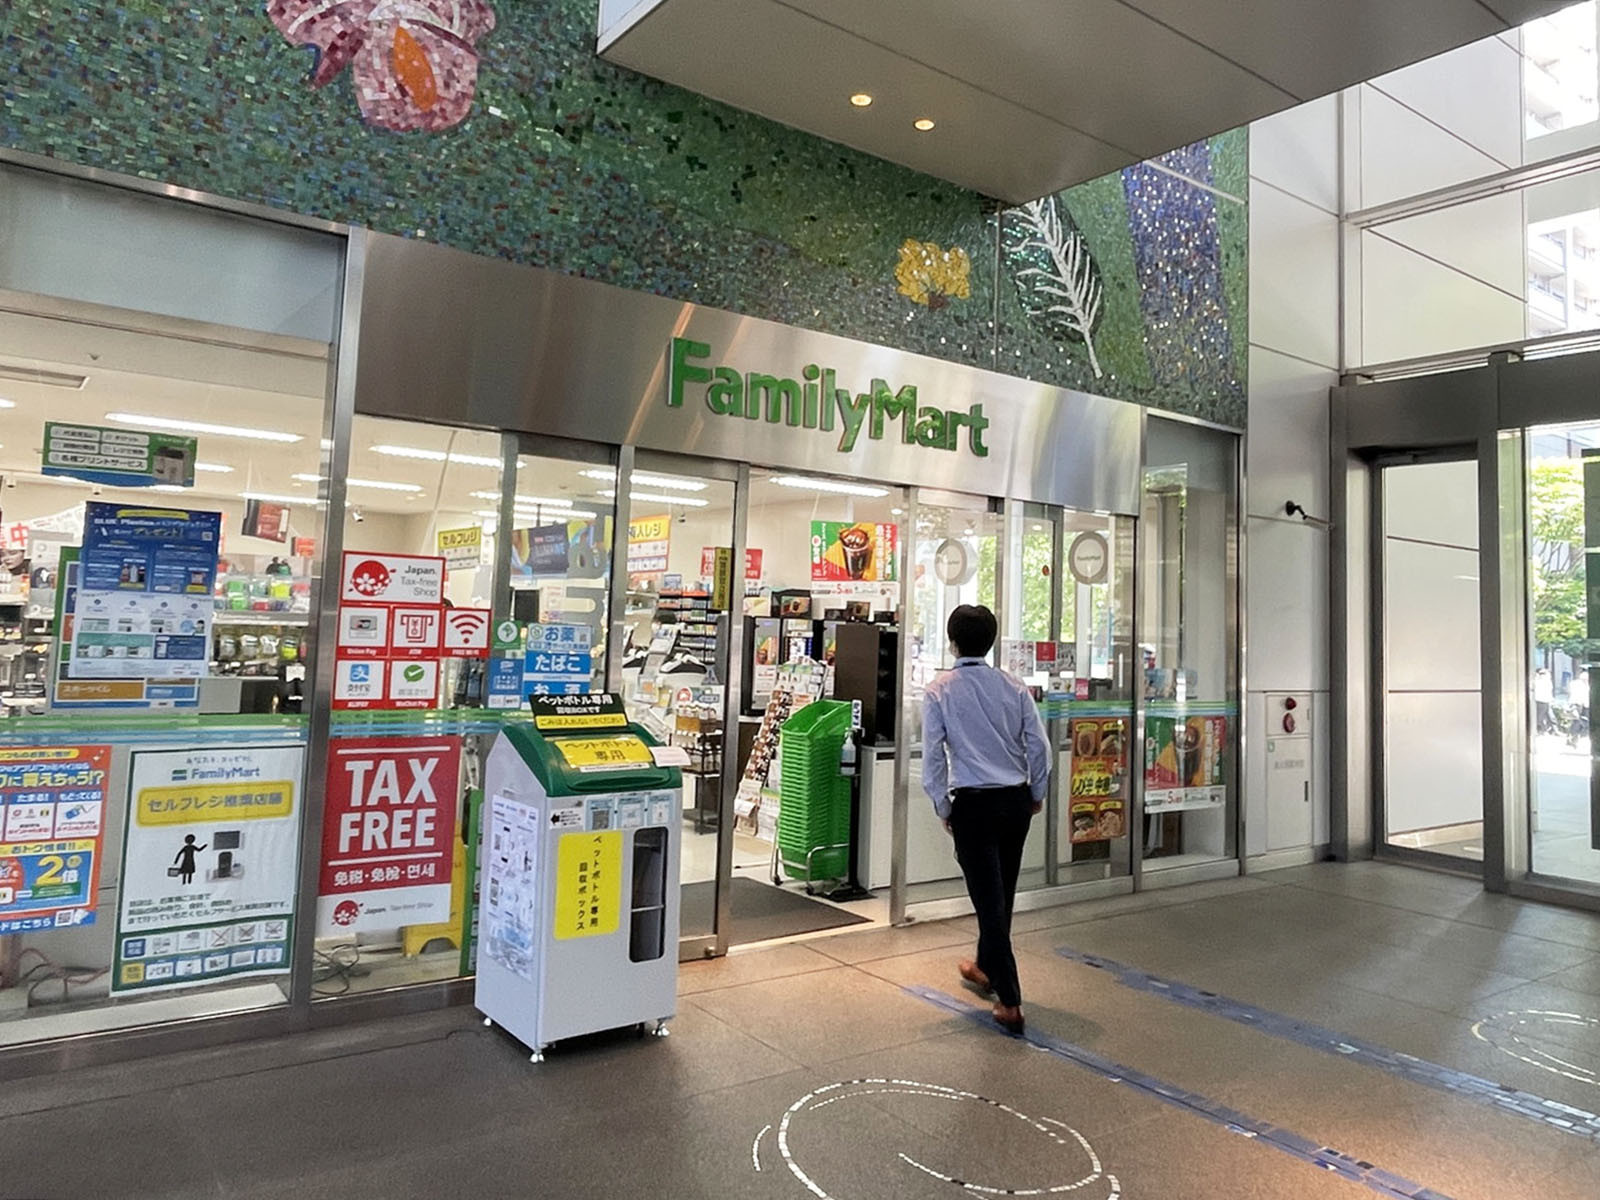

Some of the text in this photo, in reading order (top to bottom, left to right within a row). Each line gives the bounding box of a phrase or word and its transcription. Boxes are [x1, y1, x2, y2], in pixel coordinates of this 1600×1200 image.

[668, 337, 989, 457] FamilyMart
[414, 587, 437, 597] Shop
[535, 655, 580, 671] たばこ
[538, 694, 614, 706] ペットボトル専用
[564, 740, 638, 750] ペットボトル
[595, 750, 626, 761] 専用
[191, 767, 260, 780] FamilyMart
[345, 757, 440, 807] TAX
[338, 808, 436, 853] FREE
[36, 855, 64, 886] 2
